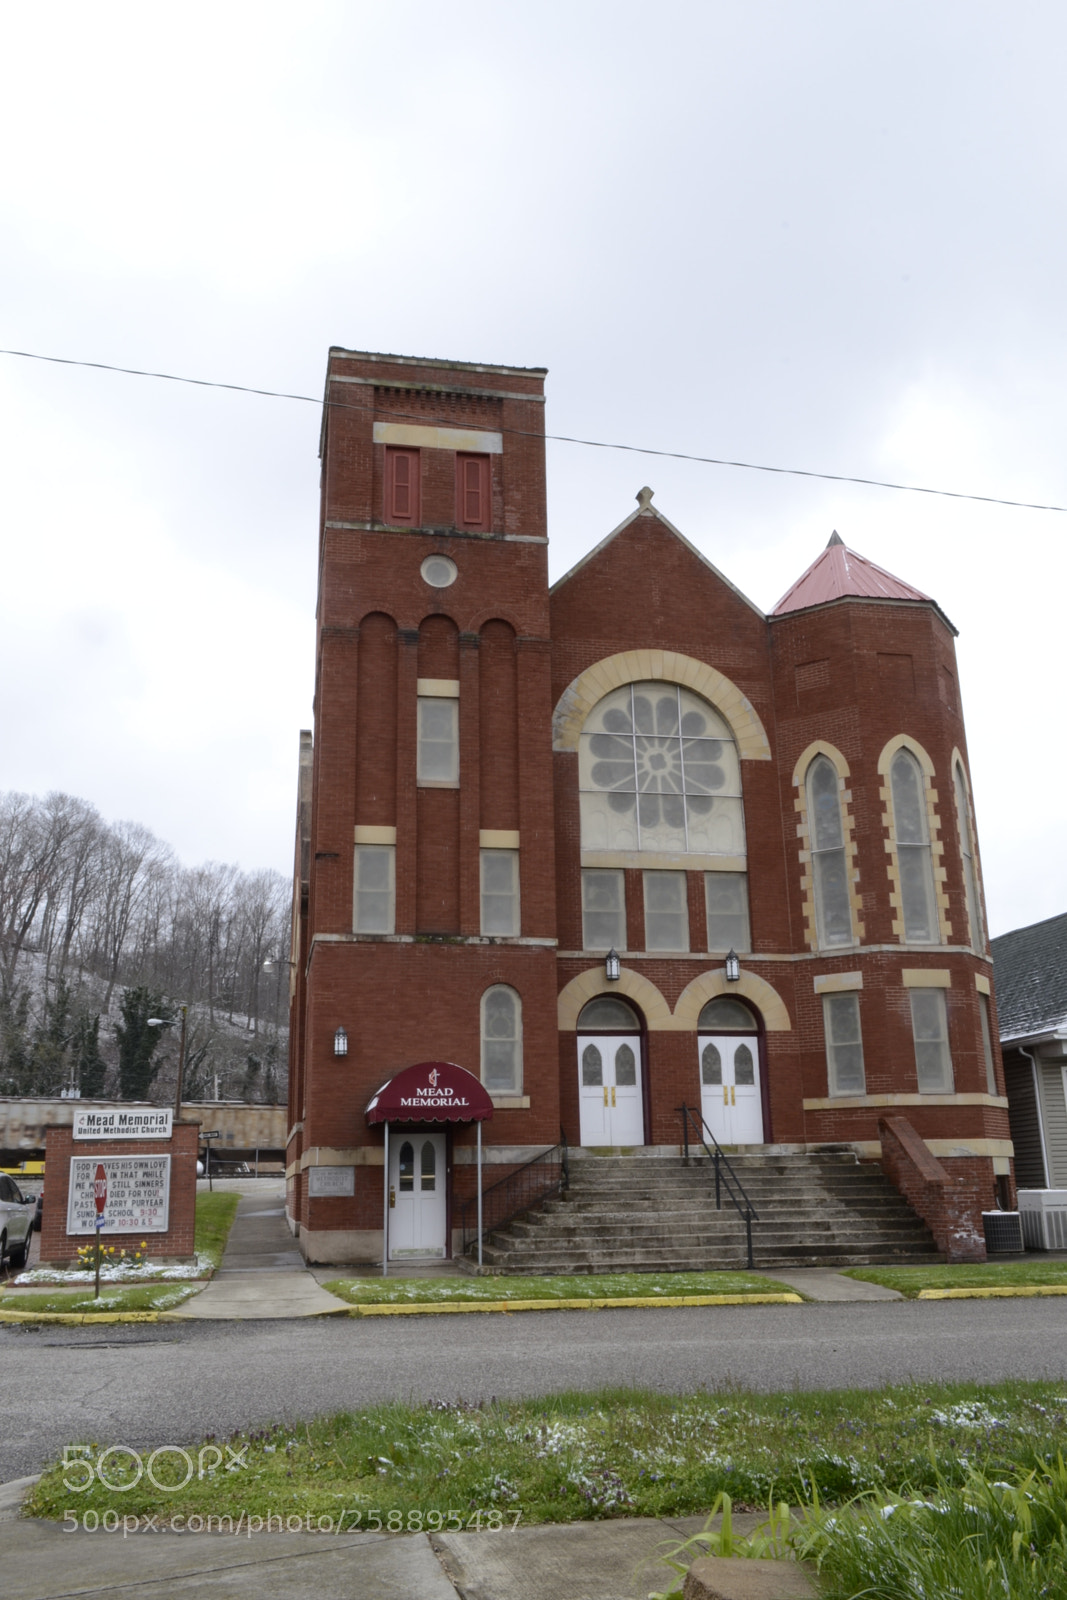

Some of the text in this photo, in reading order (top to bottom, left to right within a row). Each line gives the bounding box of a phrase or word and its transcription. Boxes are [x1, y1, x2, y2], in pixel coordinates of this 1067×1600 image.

[416, 1087, 454, 1096] MEAD
[400, 1097, 469, 1106] MEMORIAL
[86, 1113, 168, 1126] Mead Memorial
[78, 1125, 167, 1135] United Methodist Church
[92, 1162, 120, 1170] POVES
[121, 1161, 132, 1169] HIS
[133, 1161, 149, 1169] OWN
[150, 1160, 167, 1168] LOVE
[77, 1172, 90, 1180] FOR
[110, 1171, 117, 1179] IN
[142, 1170, 163, 1178] WHILE
[75, 1182, 85, 1190] WE
[134, 1180, 164, 1188] SINNERS
[95, 1179, 107, 1198] STOP
[109, 1190, 126, 1198] DIED
[128, 1190, 142, 1198] FOR
[143, 1189, 160, 1197] YOU!
[105, 1200, 128, 1208] LARRY
[131, 1199, 164, 1207] PURYEAR
[108, 1209, 135, 1217] SCHOOL
[140, 1208, 158, 1216] 9:30
[118, 1218, 139, 1226] 10:30
[148, 1218, 153, 1226] 5
